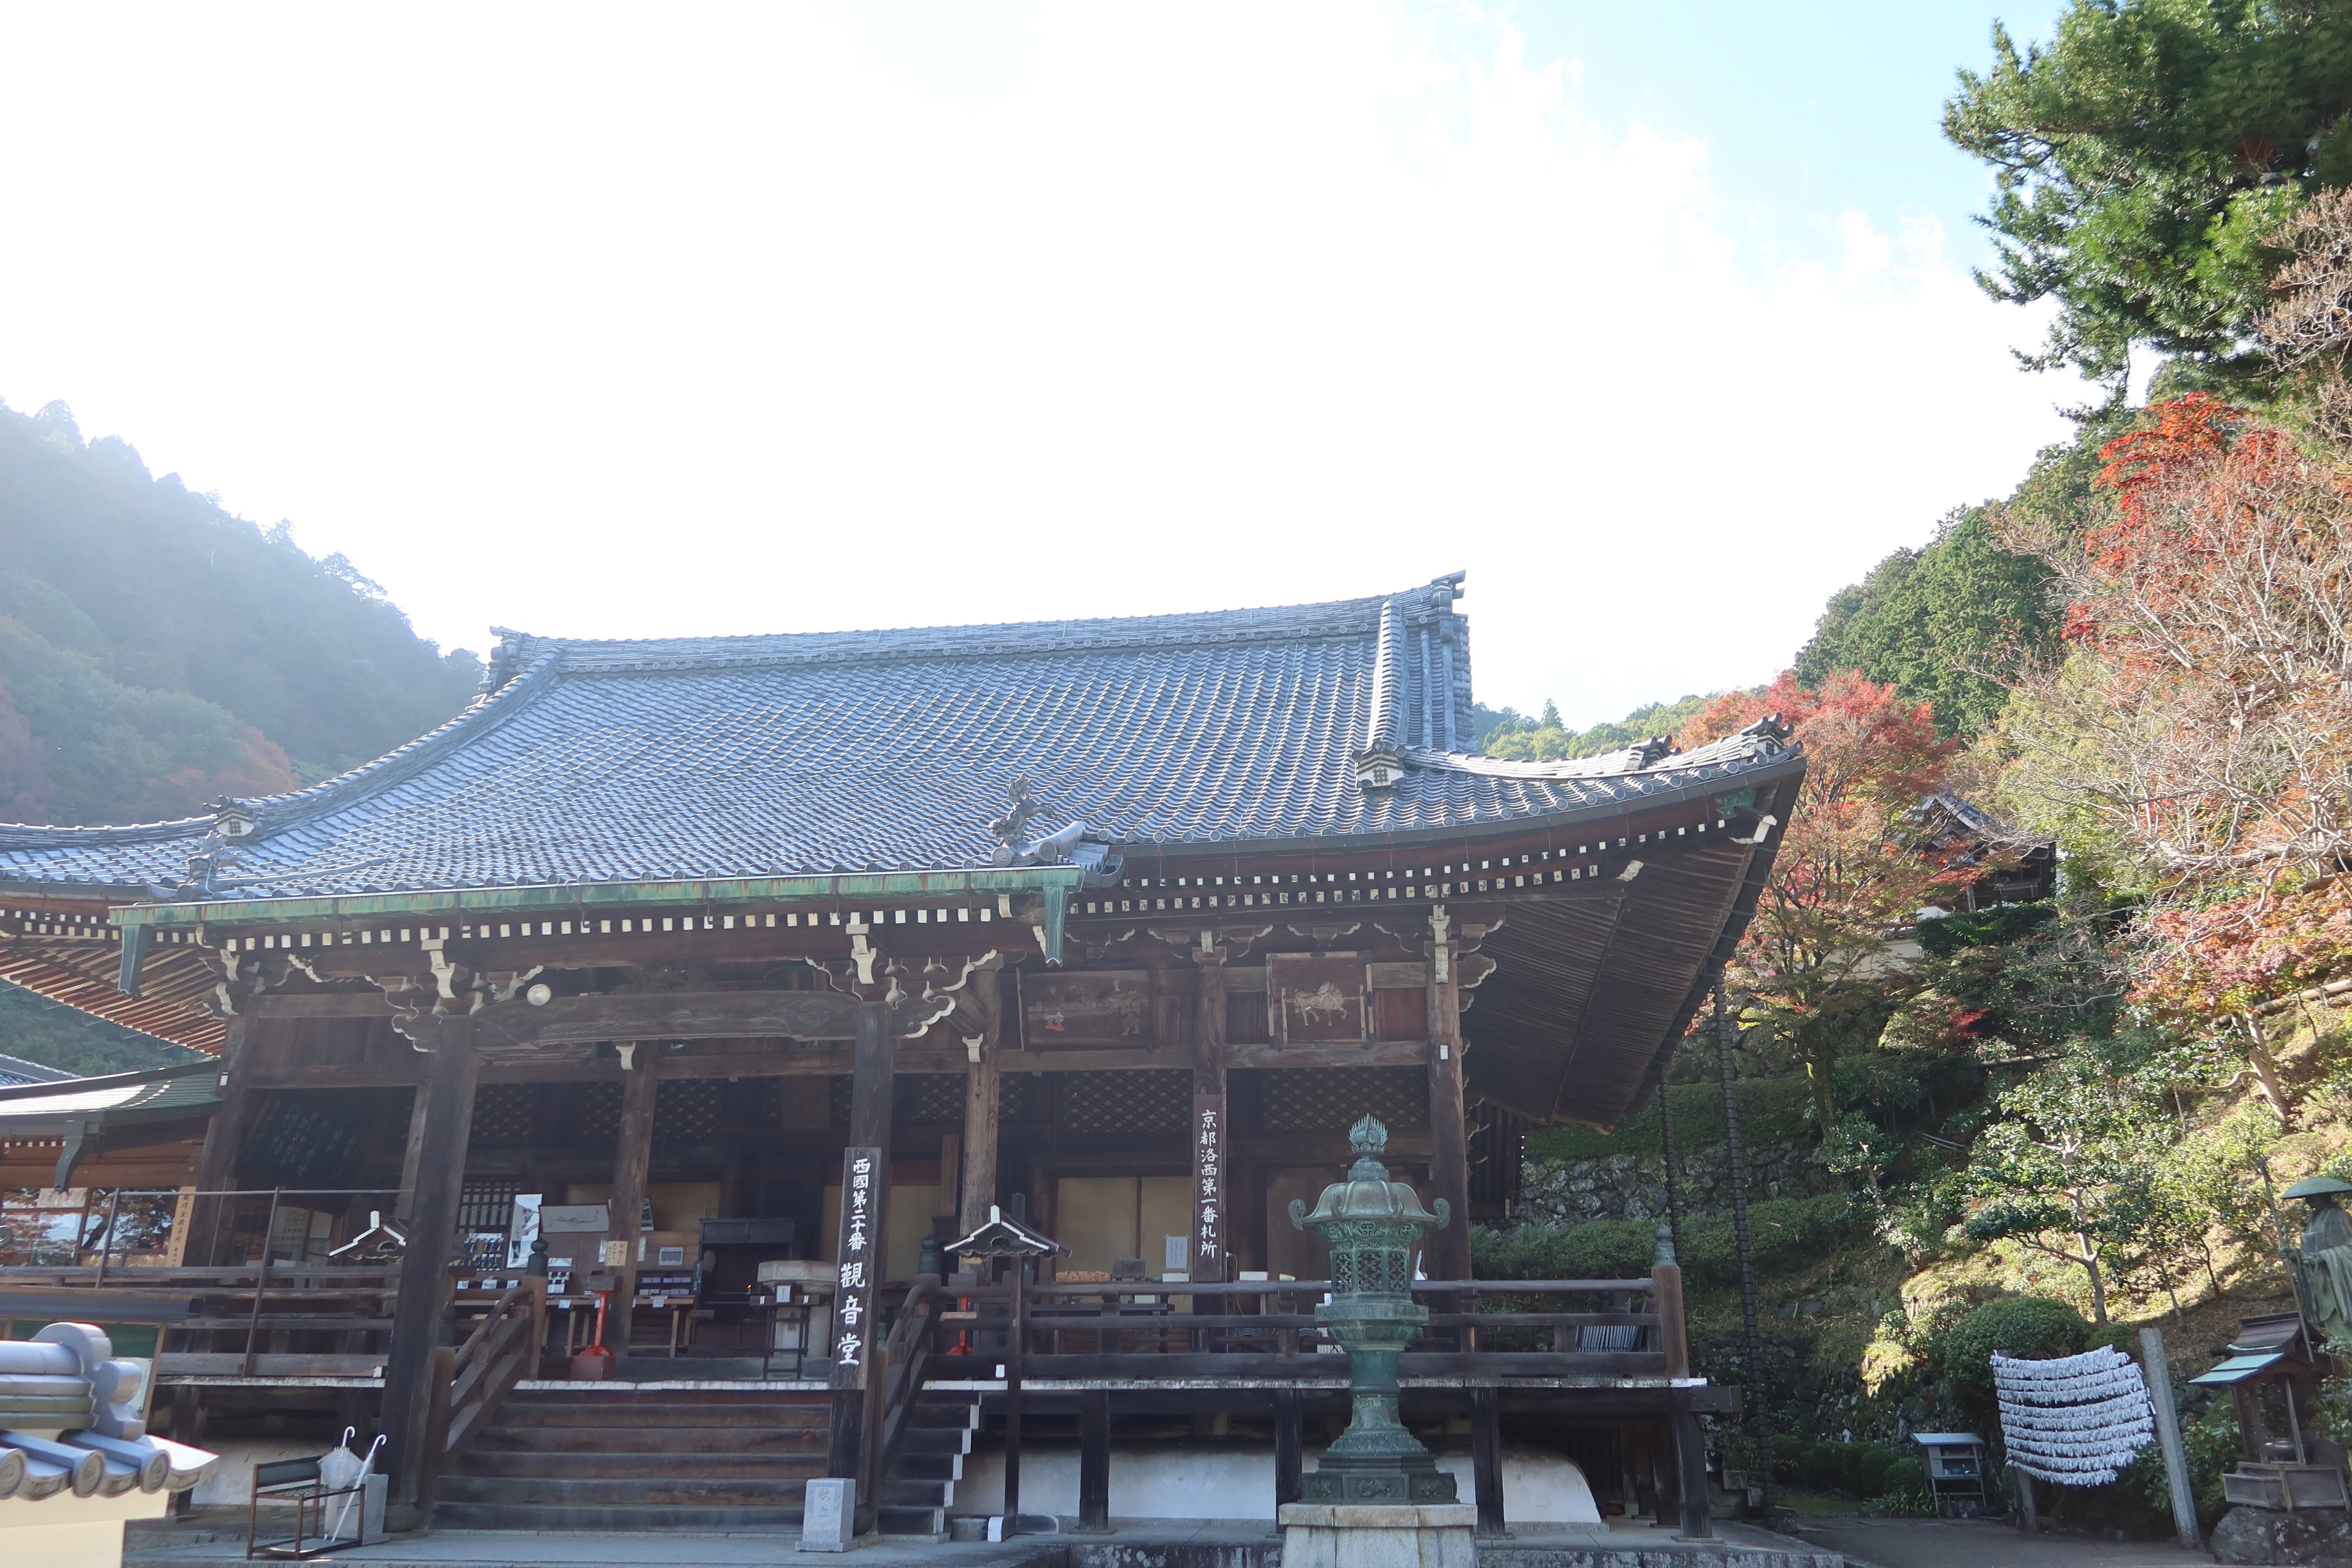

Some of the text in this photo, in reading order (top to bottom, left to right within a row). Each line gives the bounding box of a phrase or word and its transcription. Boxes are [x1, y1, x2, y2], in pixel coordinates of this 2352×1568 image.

[838, 1158, 871, 1365] 西國第二十番觀音堂
[1200, 1109, 1219, 1259] 京都洛西第一番札所
